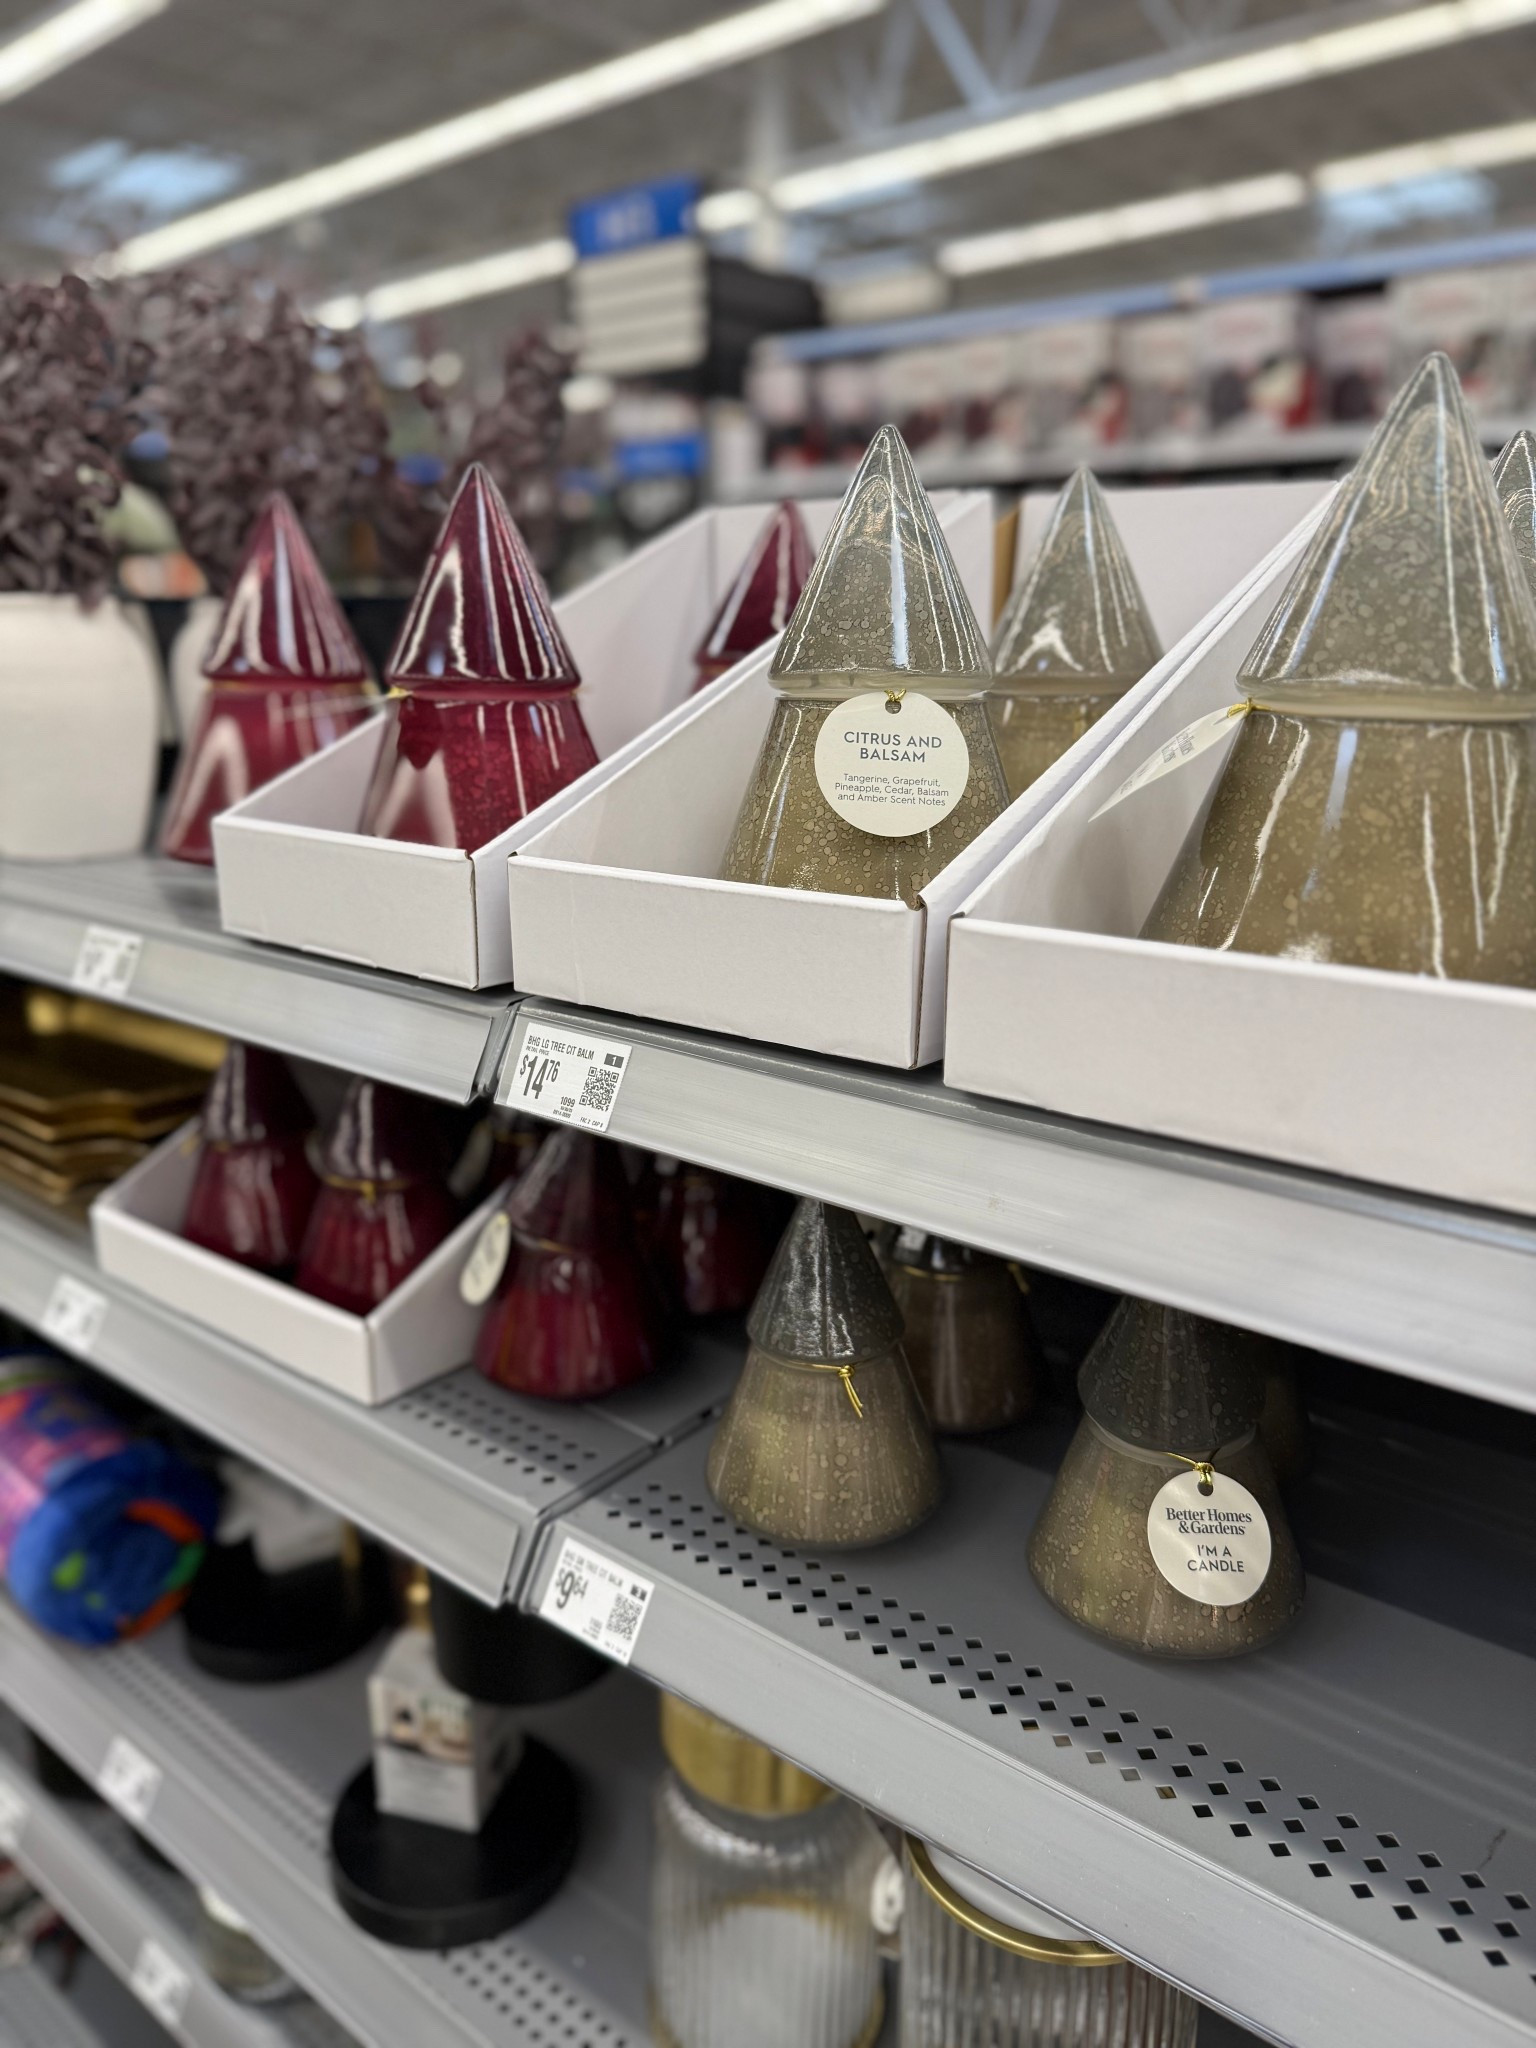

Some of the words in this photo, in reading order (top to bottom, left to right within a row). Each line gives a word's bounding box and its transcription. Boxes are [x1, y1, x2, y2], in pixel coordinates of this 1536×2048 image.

[844, 731, 901, 746] CITRUS
[907, 735, 942, 748] AND
[860, 748, 926, 763] BALSAM
[844, 773, 890, 785] Tangerine,
[892, 776, 941, 787] Grapefruit,
[835, 782, 882, 794] Pineapple,
[885, 785, 914, 796] Cedar,
[917, 787, 949, 797] Balsam
[837, 793, 855, 801] and
[857, 794, 887, 803] Amber
[890, 796, 916, 805] Scent
[918, 797, 946, 807] Notes
[528, 1035, 541, 1047] BHG
[541, 1038, 550, 1049] LG
[550, 1040, 566, 1053] TREE
[566, 1044, 577, 1056] CIT
[577, 1047, 595, 1060] BALM
[1166, 1507, 1206, 1521] Better
[1206, 1508, 1252, 1523] Homes
[1197, 1544, 1218, 1557] I'M
[1222, 1545, 1232, 1557] A
[1187, 1560, 1245, 1573] CANDLE
